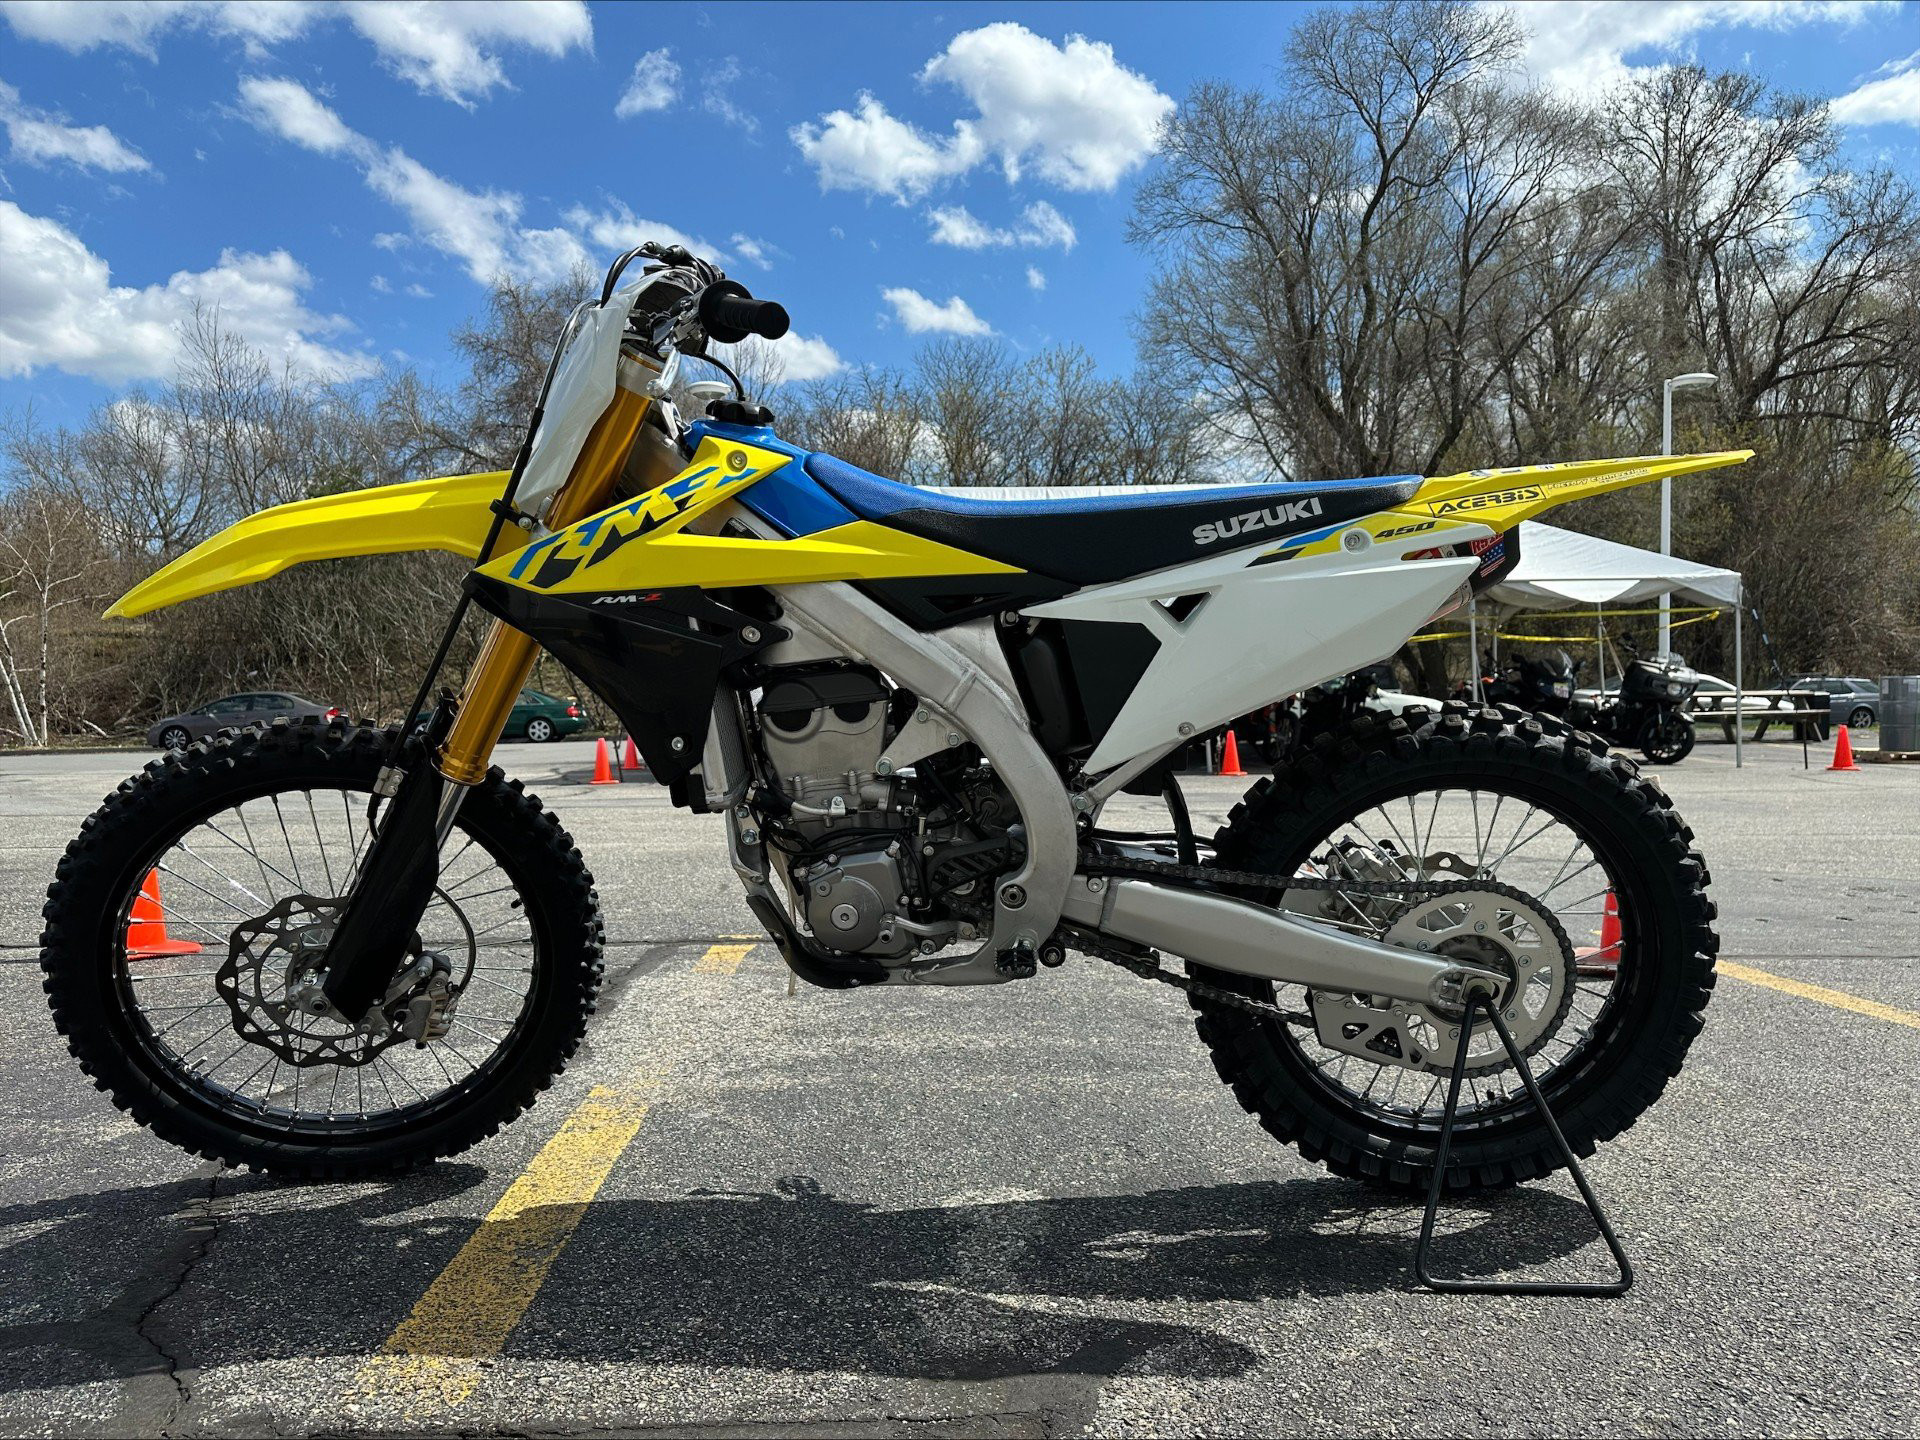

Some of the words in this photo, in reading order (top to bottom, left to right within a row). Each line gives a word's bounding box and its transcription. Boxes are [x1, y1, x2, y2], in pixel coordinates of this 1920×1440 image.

[1192, 497, 1323, 545] SUZUKI
[1373, 521, 1438, 539] 450
[591, 593, 662, 605] RM-Z
